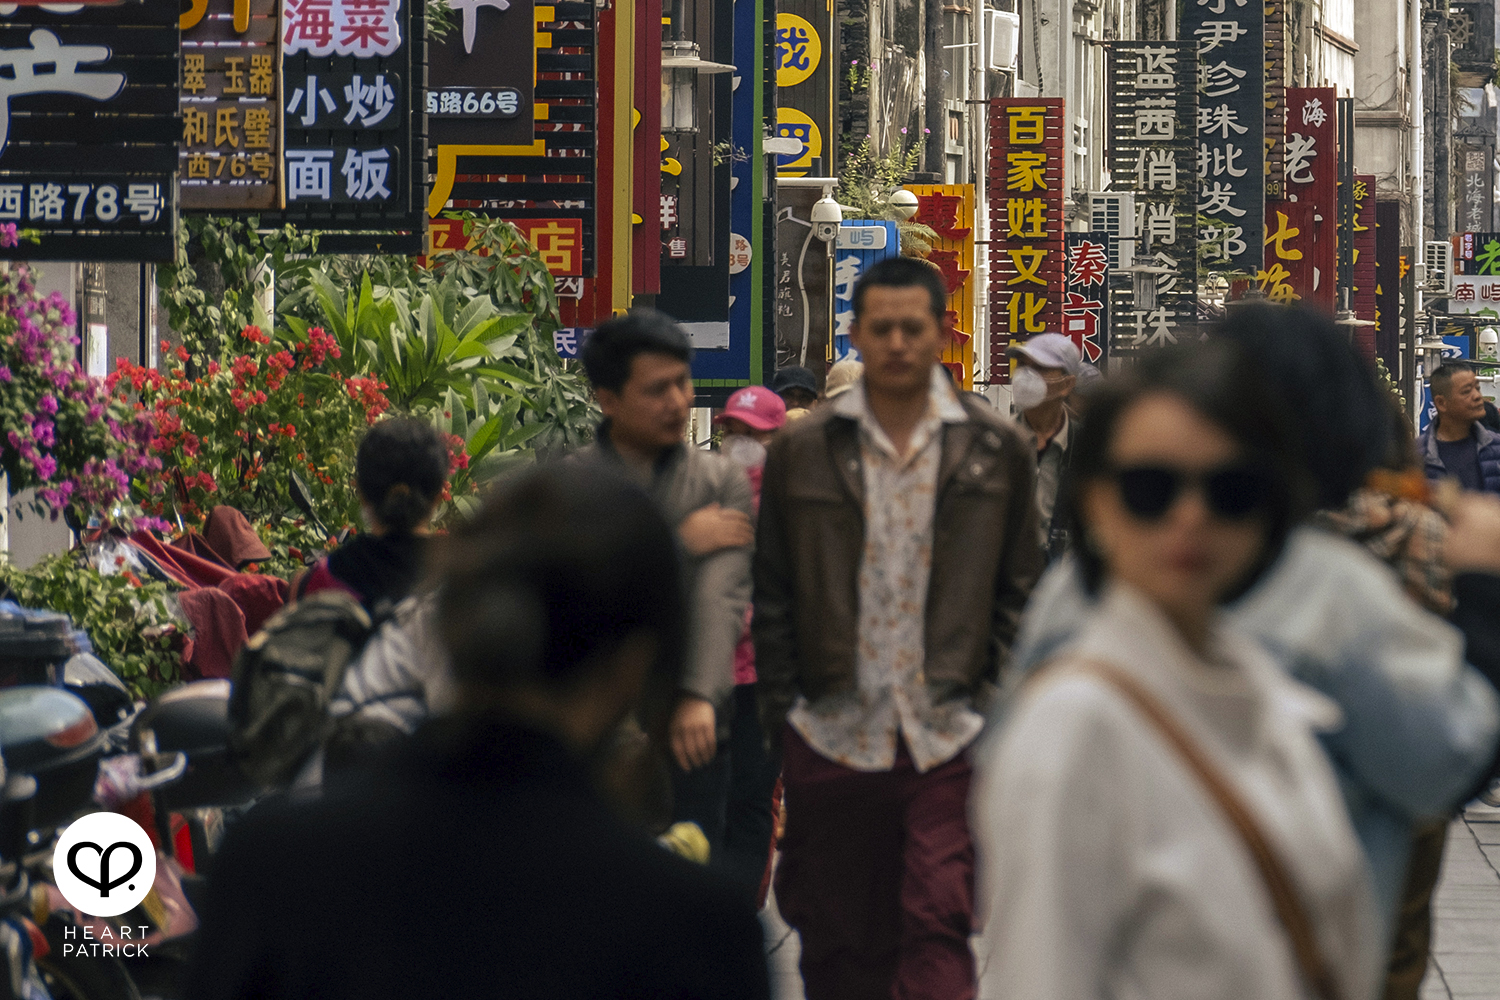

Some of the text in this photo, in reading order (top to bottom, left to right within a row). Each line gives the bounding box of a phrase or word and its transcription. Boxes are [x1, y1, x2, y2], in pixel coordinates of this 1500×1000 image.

[287, 75, 395, 128] 小炒
[427, 91, 518, 114] 西路66号
[182, 106, 272, 148] 和氏璧
[286, 148, 392, 201] 面饭
[0, 183, 159, 223] 西路78号
[1005, 106, 1048, 375] 百家姓文化
